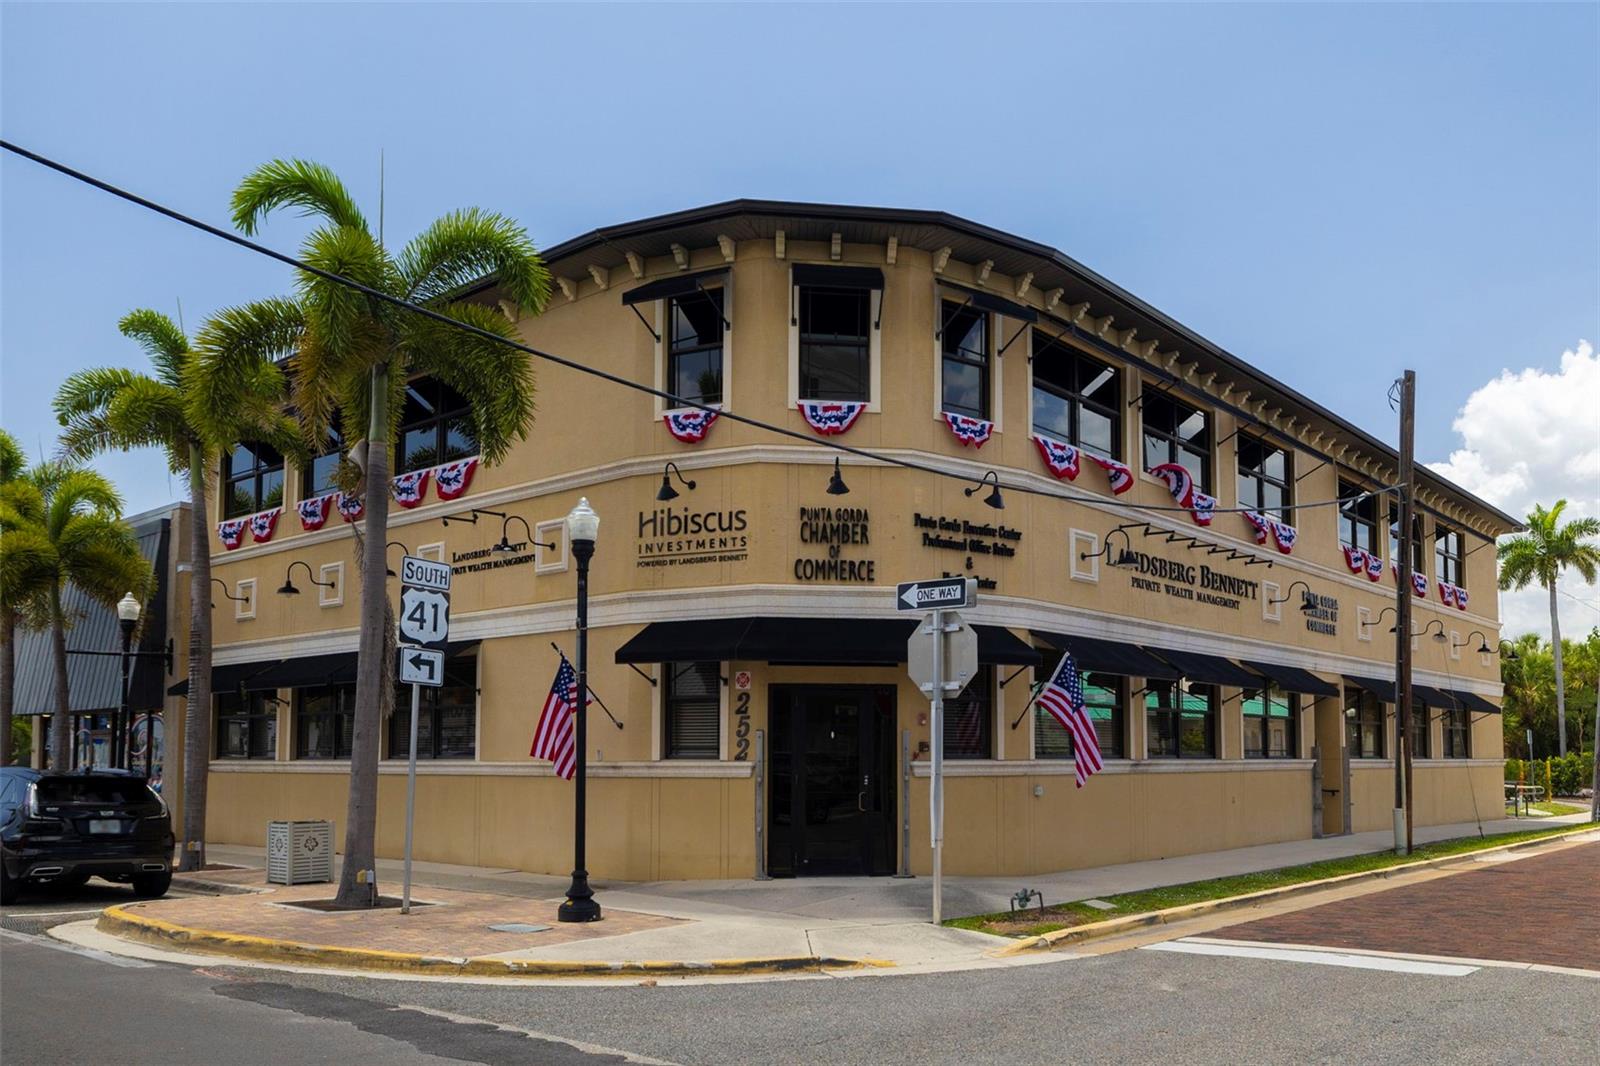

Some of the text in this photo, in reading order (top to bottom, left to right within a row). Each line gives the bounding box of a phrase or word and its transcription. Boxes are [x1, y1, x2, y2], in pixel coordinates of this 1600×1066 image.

[638, 507, 748, 538] Hibiscus
[800, 507, 869, 522] PUNTA GORDA
[800, 521, 869, 544] CHAMBER
[638, 536, 748, 554] INVESTMENTS
[829, 545, 840, 558] OF
[637, 560, 668, 568] POWERED
[678, 556, 717, 566] LANDSBERG
[719, 554, 748, 562] BENNETT
[794, 558, 875, 581] COMMERCE
[966, 557, 974, 570] &
[1106, 542, 1259, 600] LADSBERG BENNETT
[405, 561, 448, 585] SOUTH
[917, 586, 958, 601] ONE WAY
[1131, 577, 1240, 610] PRIVATE WEALTH MANAGEMENT
[407, 601, 438, 632] 41
[734, 692, 751, 761] 252
